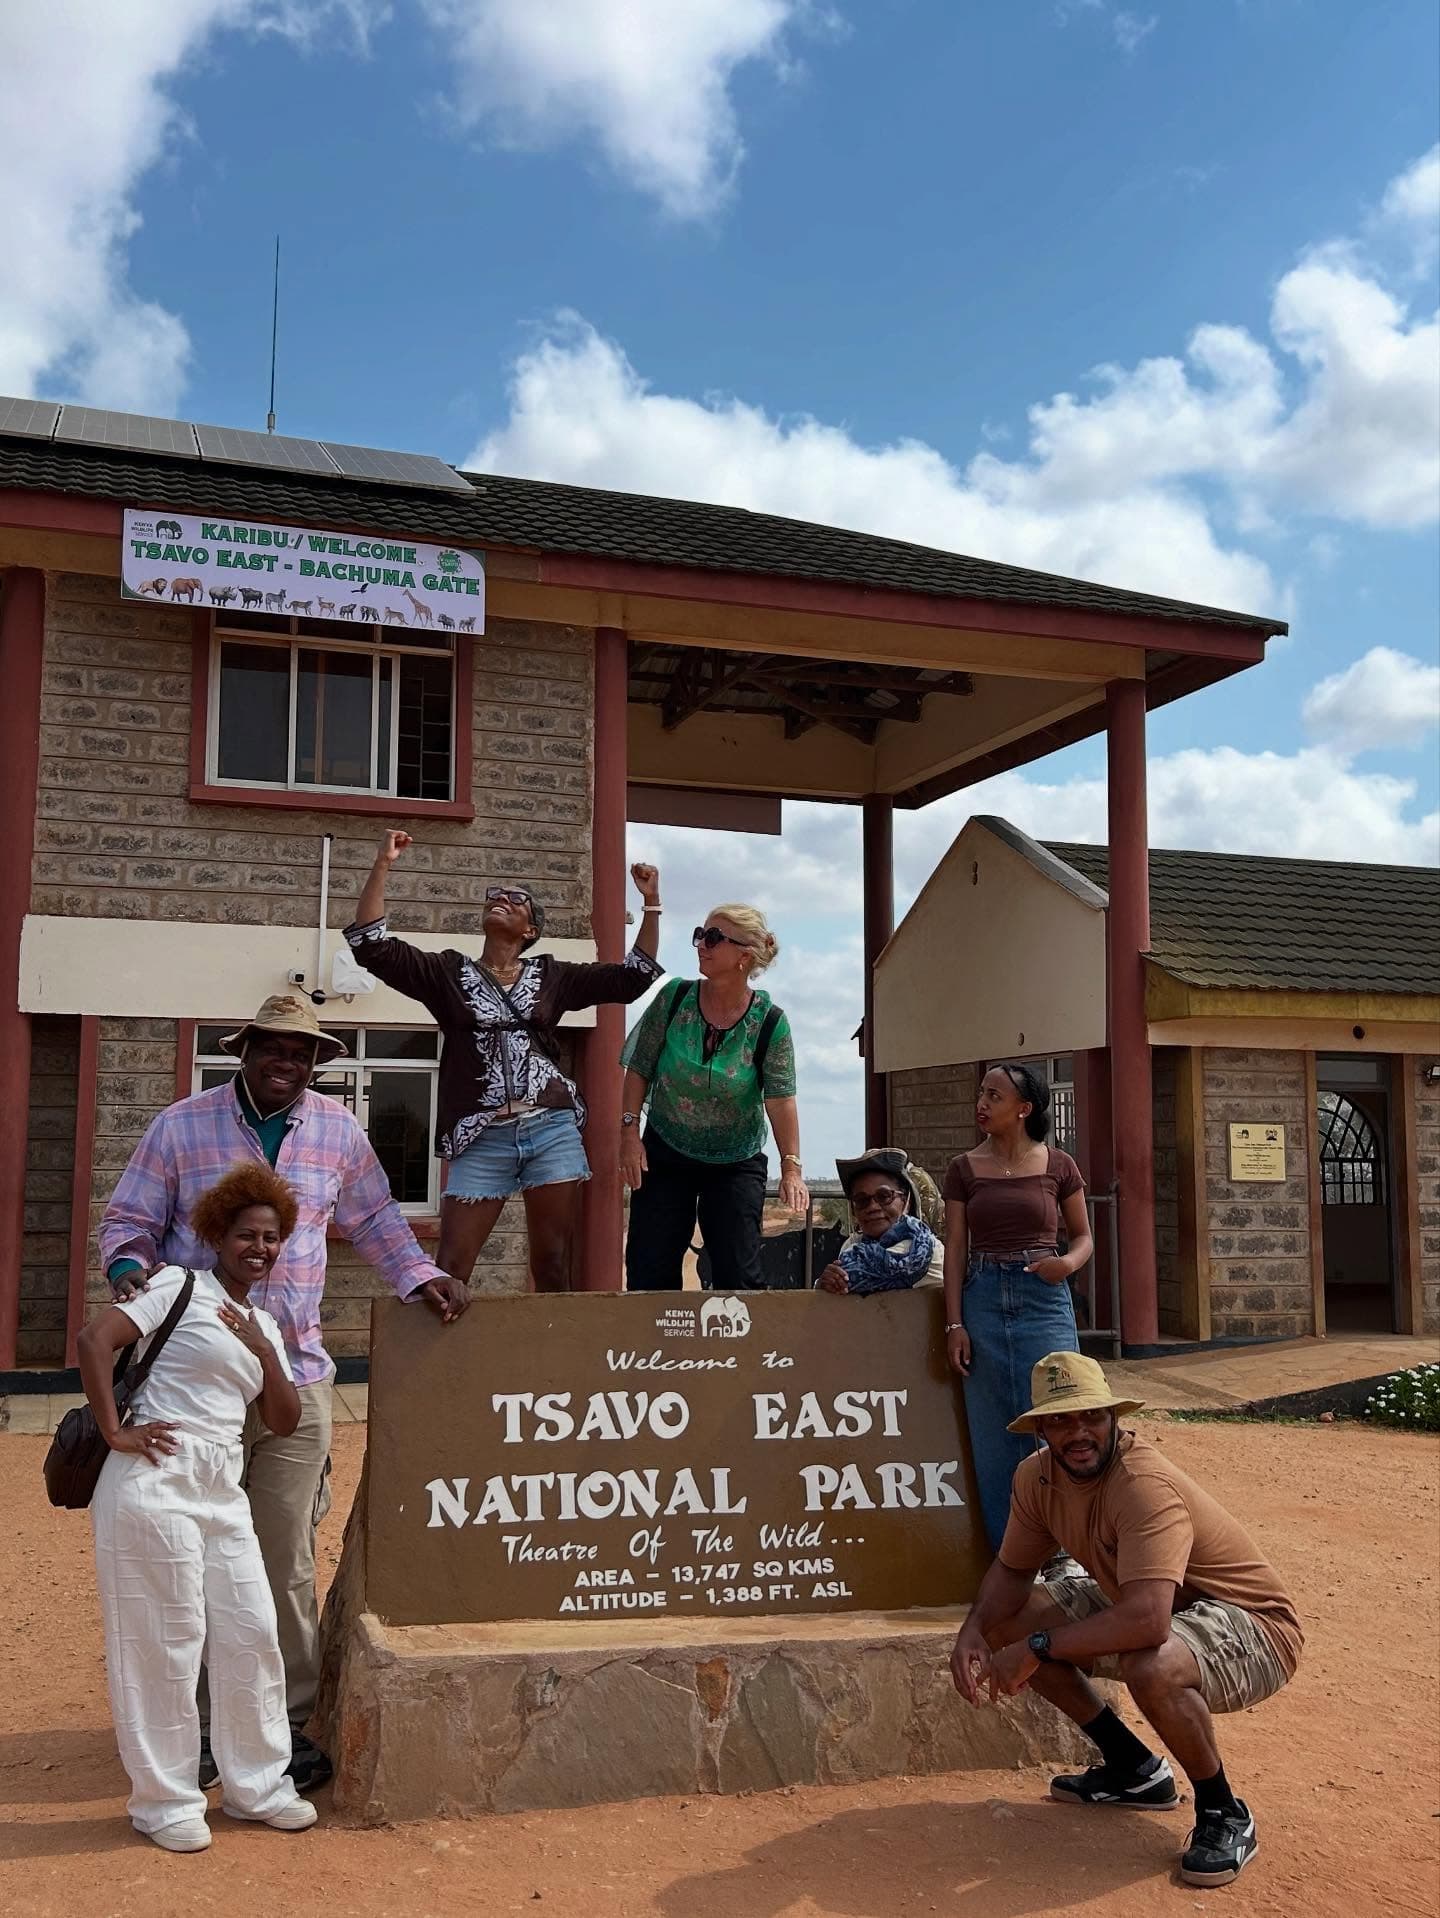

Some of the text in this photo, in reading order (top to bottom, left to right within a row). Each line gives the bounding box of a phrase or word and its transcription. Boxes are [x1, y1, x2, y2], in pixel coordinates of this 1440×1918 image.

[201, 523, 289, 548] KARIBU
[308, 535, 417, 564] WELCOME
[131, 540, 209, 565] TSAVO
[216, 549, 278, 573] EAST
[299, 558, 416, 589] BACHUMA
[422, 574, 480, 596] GATE
[655, 1318, 695, 1328] WILDLIFE
[665, 1309, 695, 1318] KENYA
[663, 1328, 695, 1337] SERVICE
[606, 1349, 794, 1371] Welcome to
[492, 1389, 908, 1443] TSAVO EAST
[425, 1460, 965, 1529] NATIONAL PARK
[501, 1534, 598, 1564] Theatre
[629, 1525, 666, 1567] Of
[691, 1529, 734, 1554] The
[574, 1568, 635, 1588] AREA
[671, 1563, 741, 1585] 13,747
[753, 1560, 784, 1577] SQ
[788, 1557, 835, 1576] KMS
[558, 1590, 668, 1612] ALTITUDE
[706, 1586, 763, 1605] 1,388
[768, 1583, 800, 1601] FT.
[811, 1581, 853, 1598] ASL
